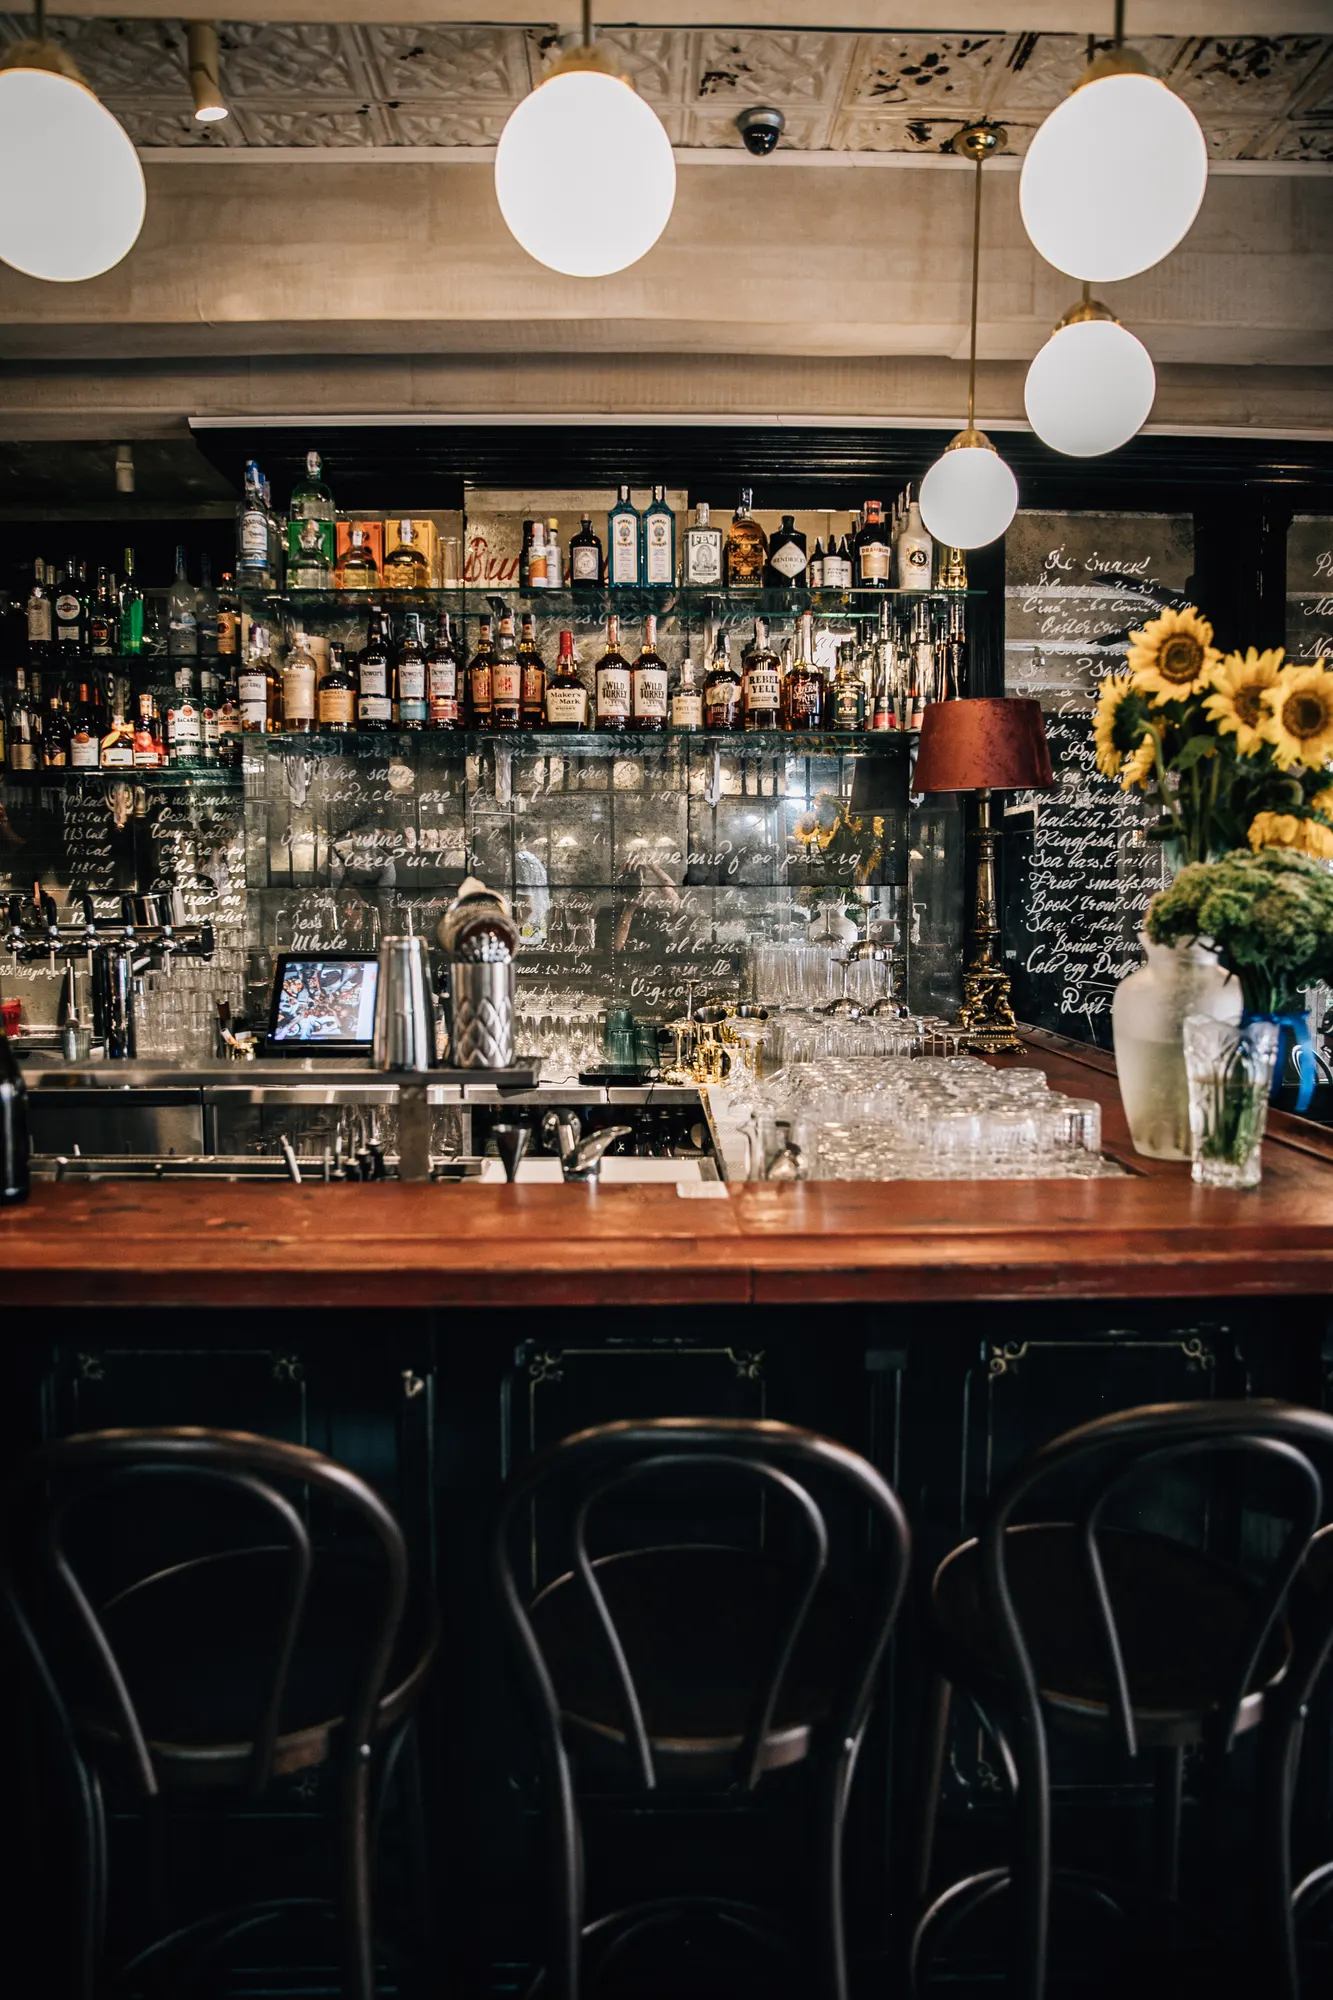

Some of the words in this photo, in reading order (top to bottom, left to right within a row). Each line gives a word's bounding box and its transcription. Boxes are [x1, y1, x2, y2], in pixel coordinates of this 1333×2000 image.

[912, 550, 926, 563] 43
[749, 675, 779, 684] REBEL
[606, 681, 625, 690] WILD
[644, 681, 662, 690] WILD
[752, 685, 777, 694] YELL
[551, 691, 581, 699] Maker's
[602, 688, 627, 698] TURKEY
[640, 688, 664, 698] TURKEY
[1028, 849, 1065, 868] Sea
[93, 896, 120, 909] Cal
[289, 932, 348, 952] White
